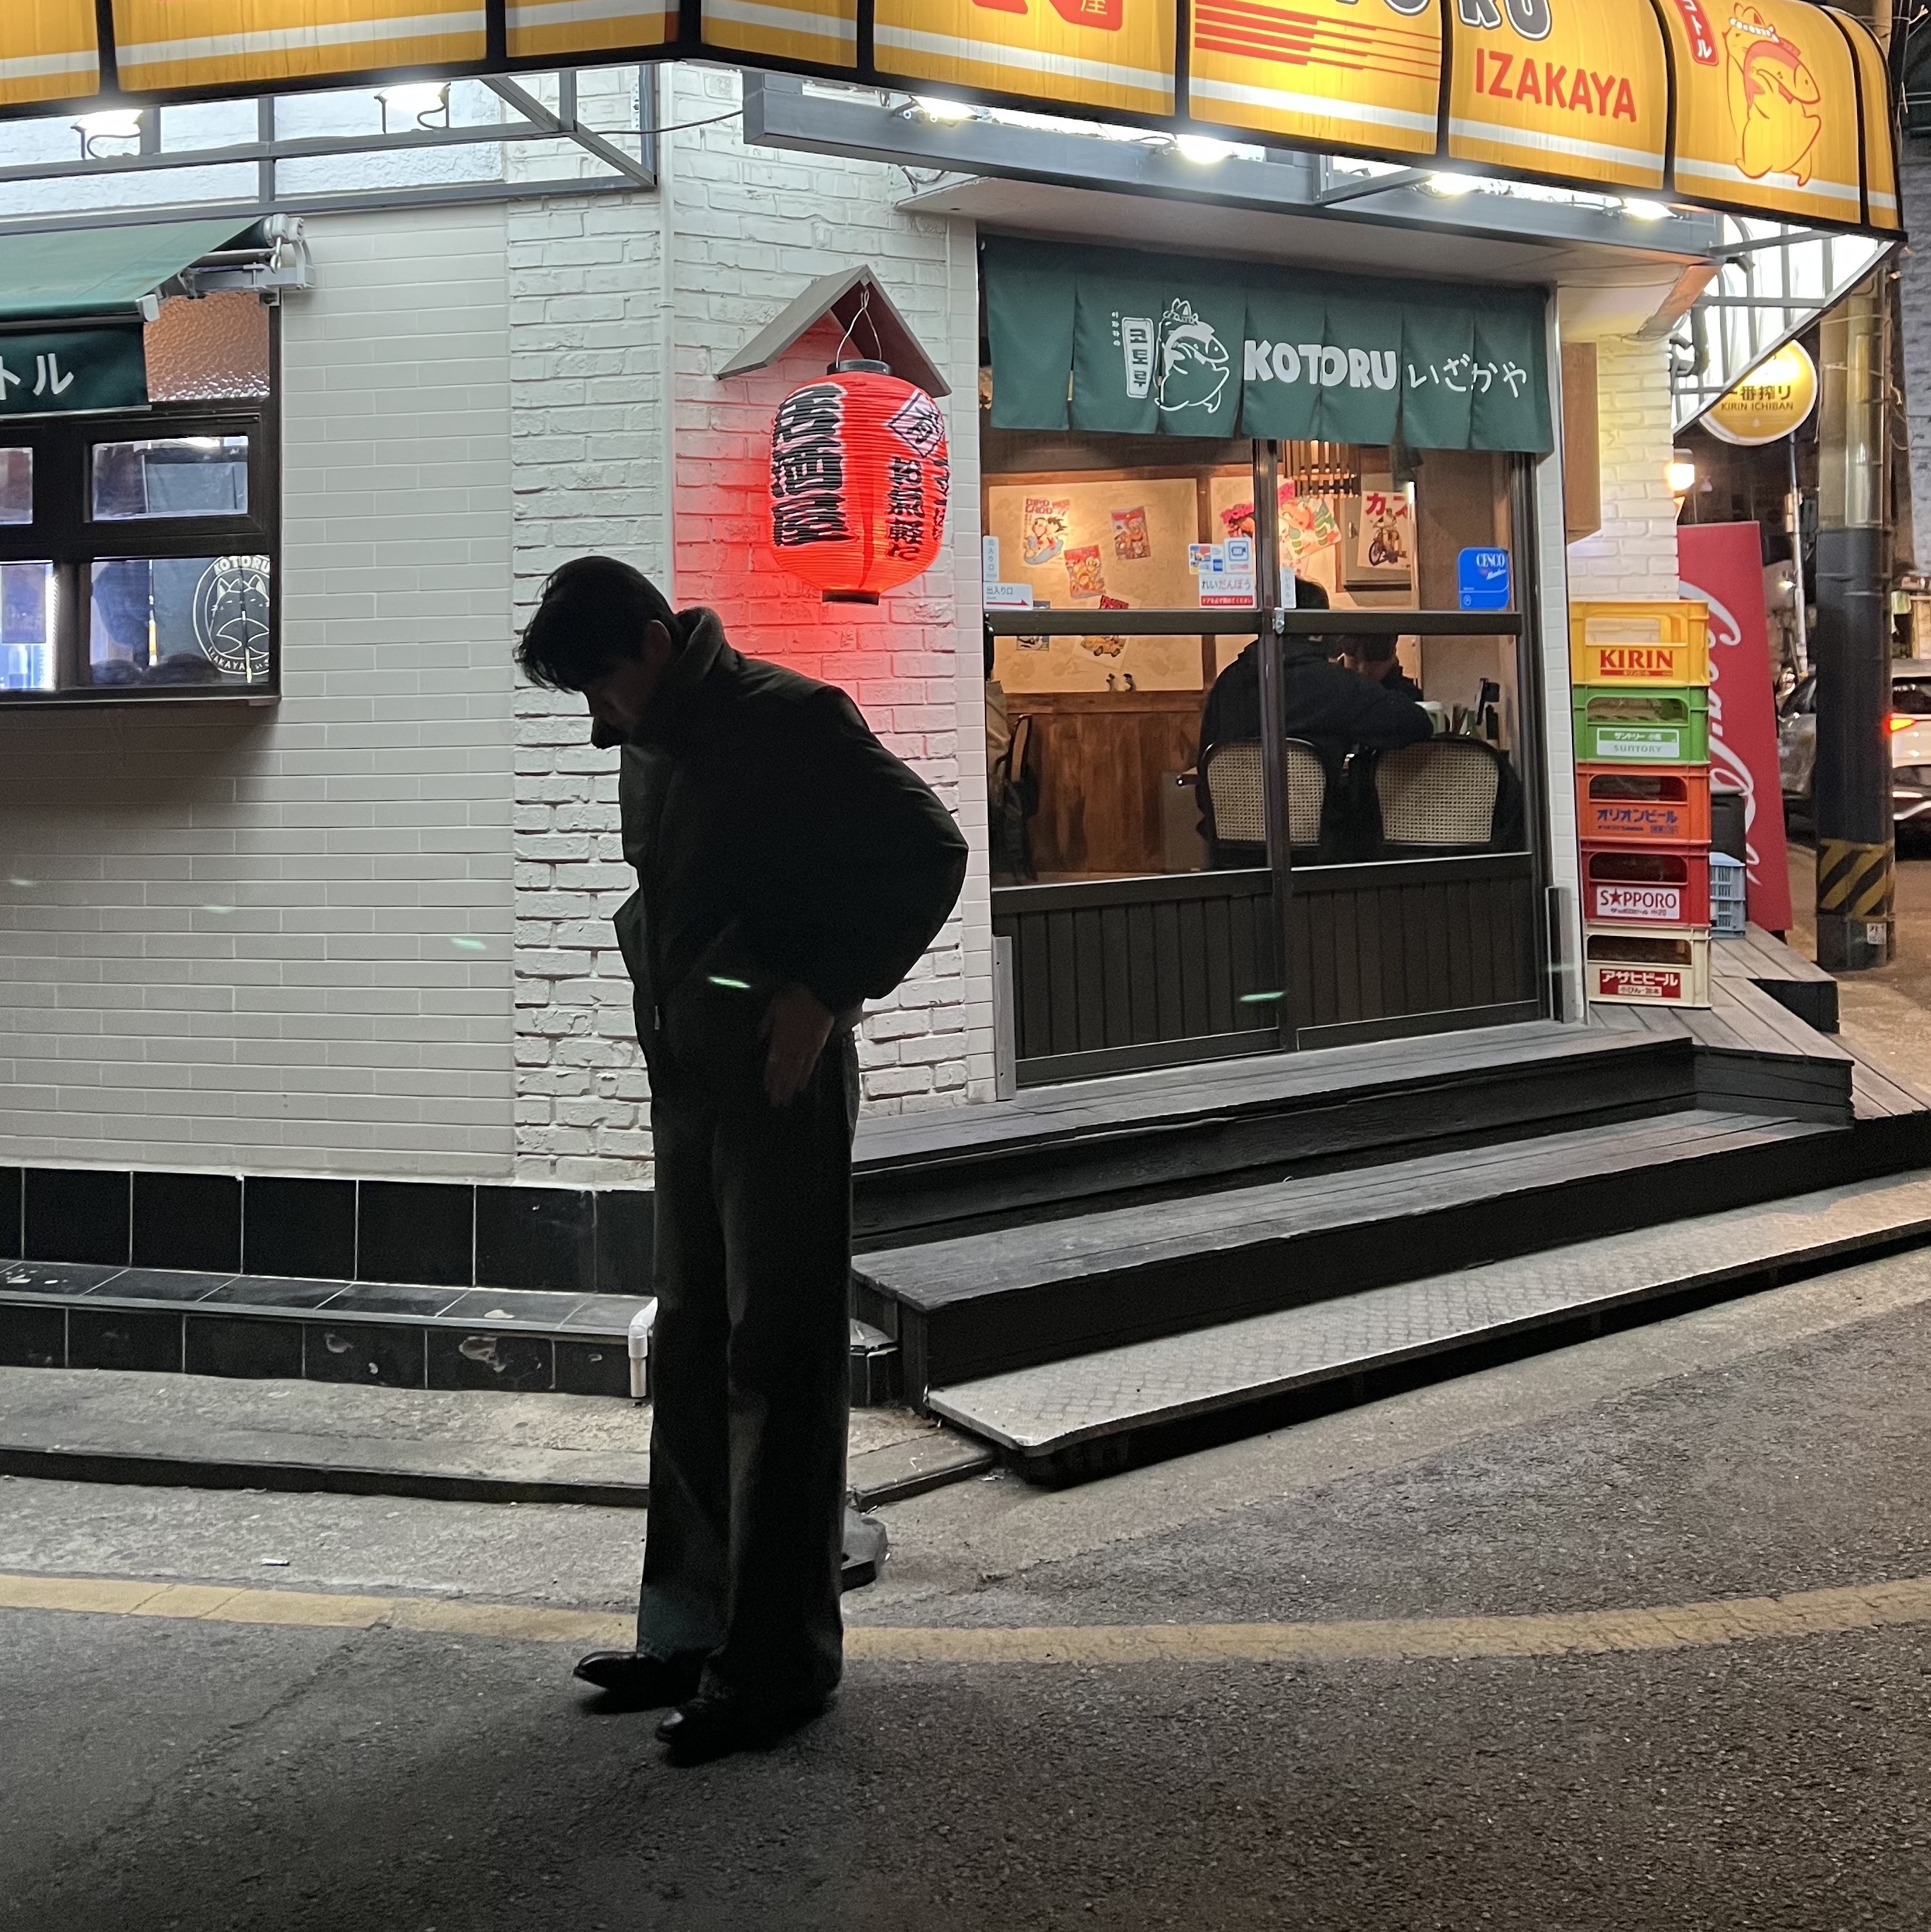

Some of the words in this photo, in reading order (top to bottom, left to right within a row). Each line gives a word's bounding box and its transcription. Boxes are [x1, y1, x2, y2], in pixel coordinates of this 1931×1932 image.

[1476, 47, 1638, 123] IZAKAYA
[0, 353, 74, 401] トル
[1244, 339, 1398, 391] KOTORU
[1408, 353, 1527, 399] いざかや
[1721, 402, 1748, 411] KIRIN
[1752, 402, 1793, 411] ICHIBAN
[213, 555, 270, 576] KOTORU
[1476, 553, 1506, 569] CESCO
[986, 586, 1013, 596] 出入り口
[1201, 578, 1251, 590] れいだんぼう
[1600, 650, 1673, 669] KIRIN
[1614, 744, 1662, 753] SUNTORY
[1597, 808, 1678, 824] オリオンビール
[1601, 970, 1678, 987] アサヒビール
